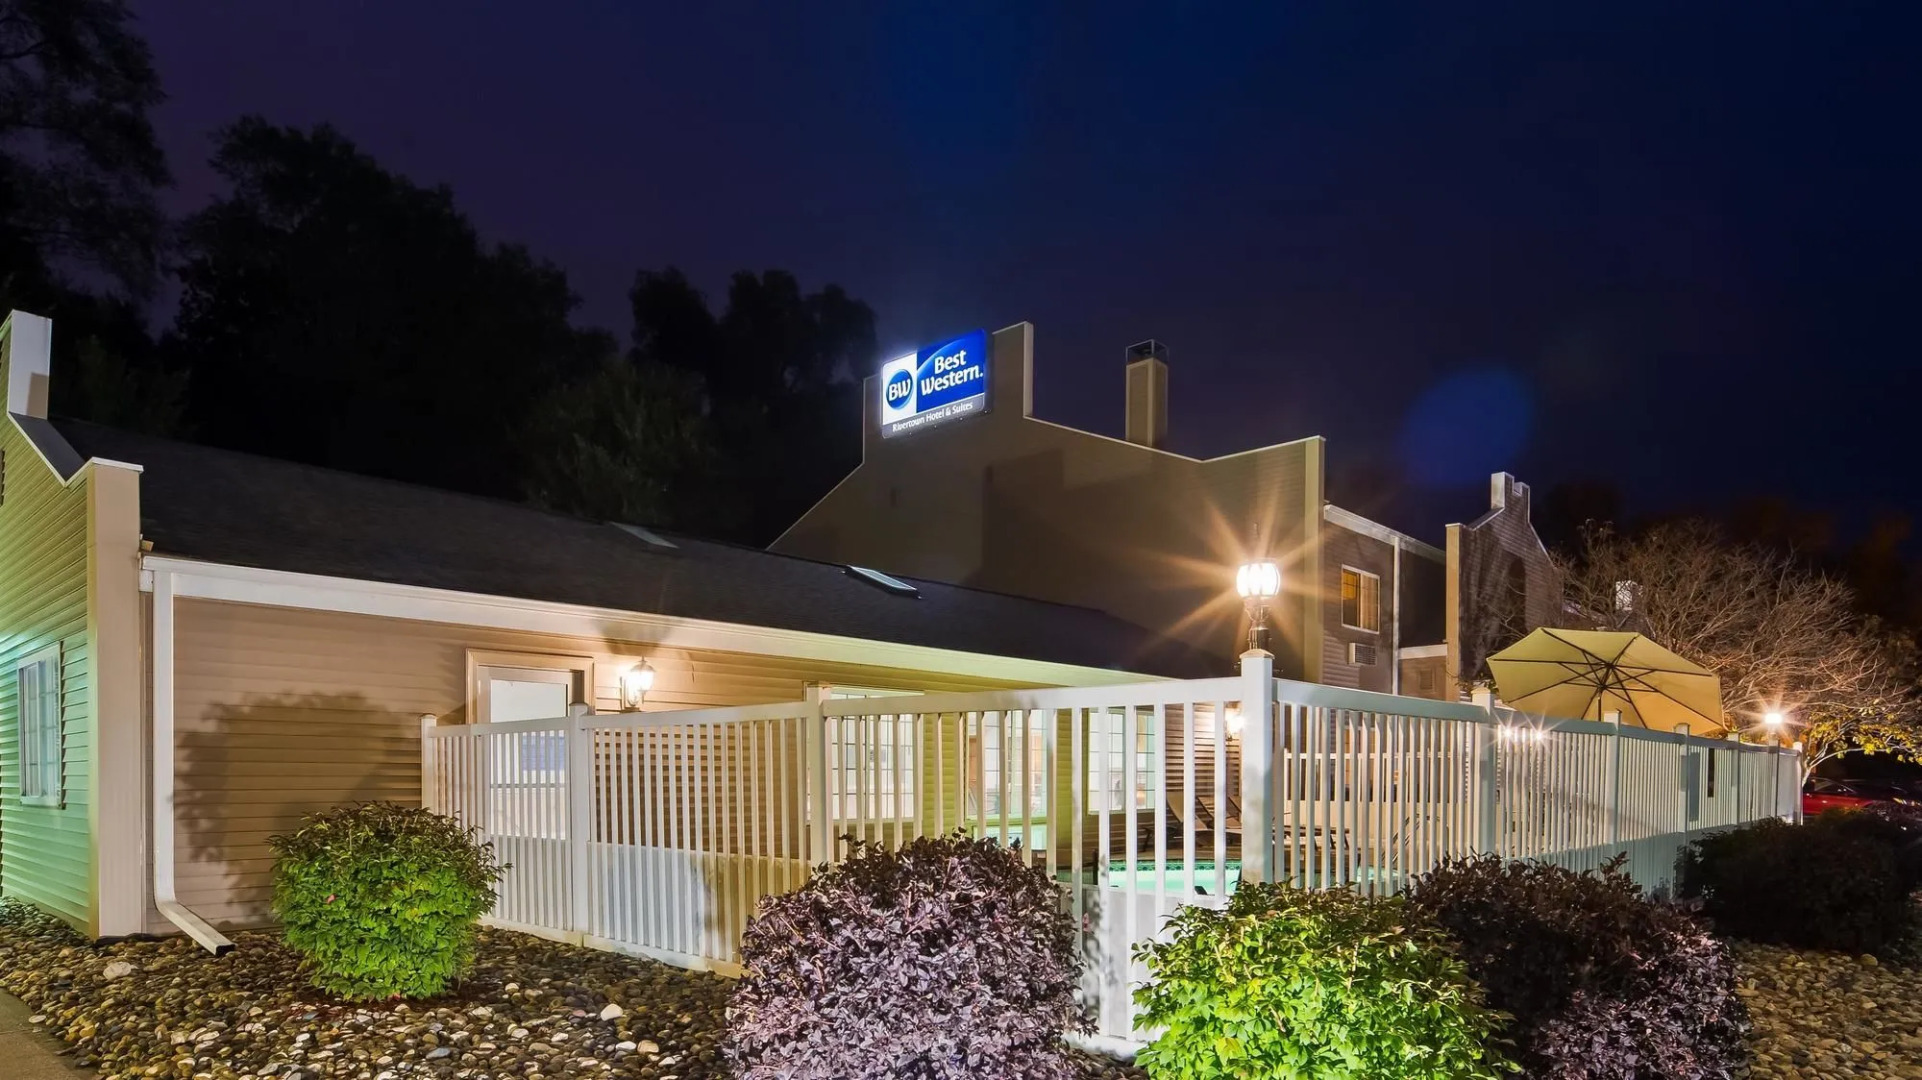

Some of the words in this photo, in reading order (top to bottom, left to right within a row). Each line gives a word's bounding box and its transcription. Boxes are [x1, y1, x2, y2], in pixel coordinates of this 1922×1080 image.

[934, 350, 966, 374] Best
[888, 379, 911, 402] BW
[892, 417, 925, 431] Rivertown
[926, 410, 945, 422] Hotel
[945, 407, 952, 416] &
[952, 401, 973, 415] Suites
